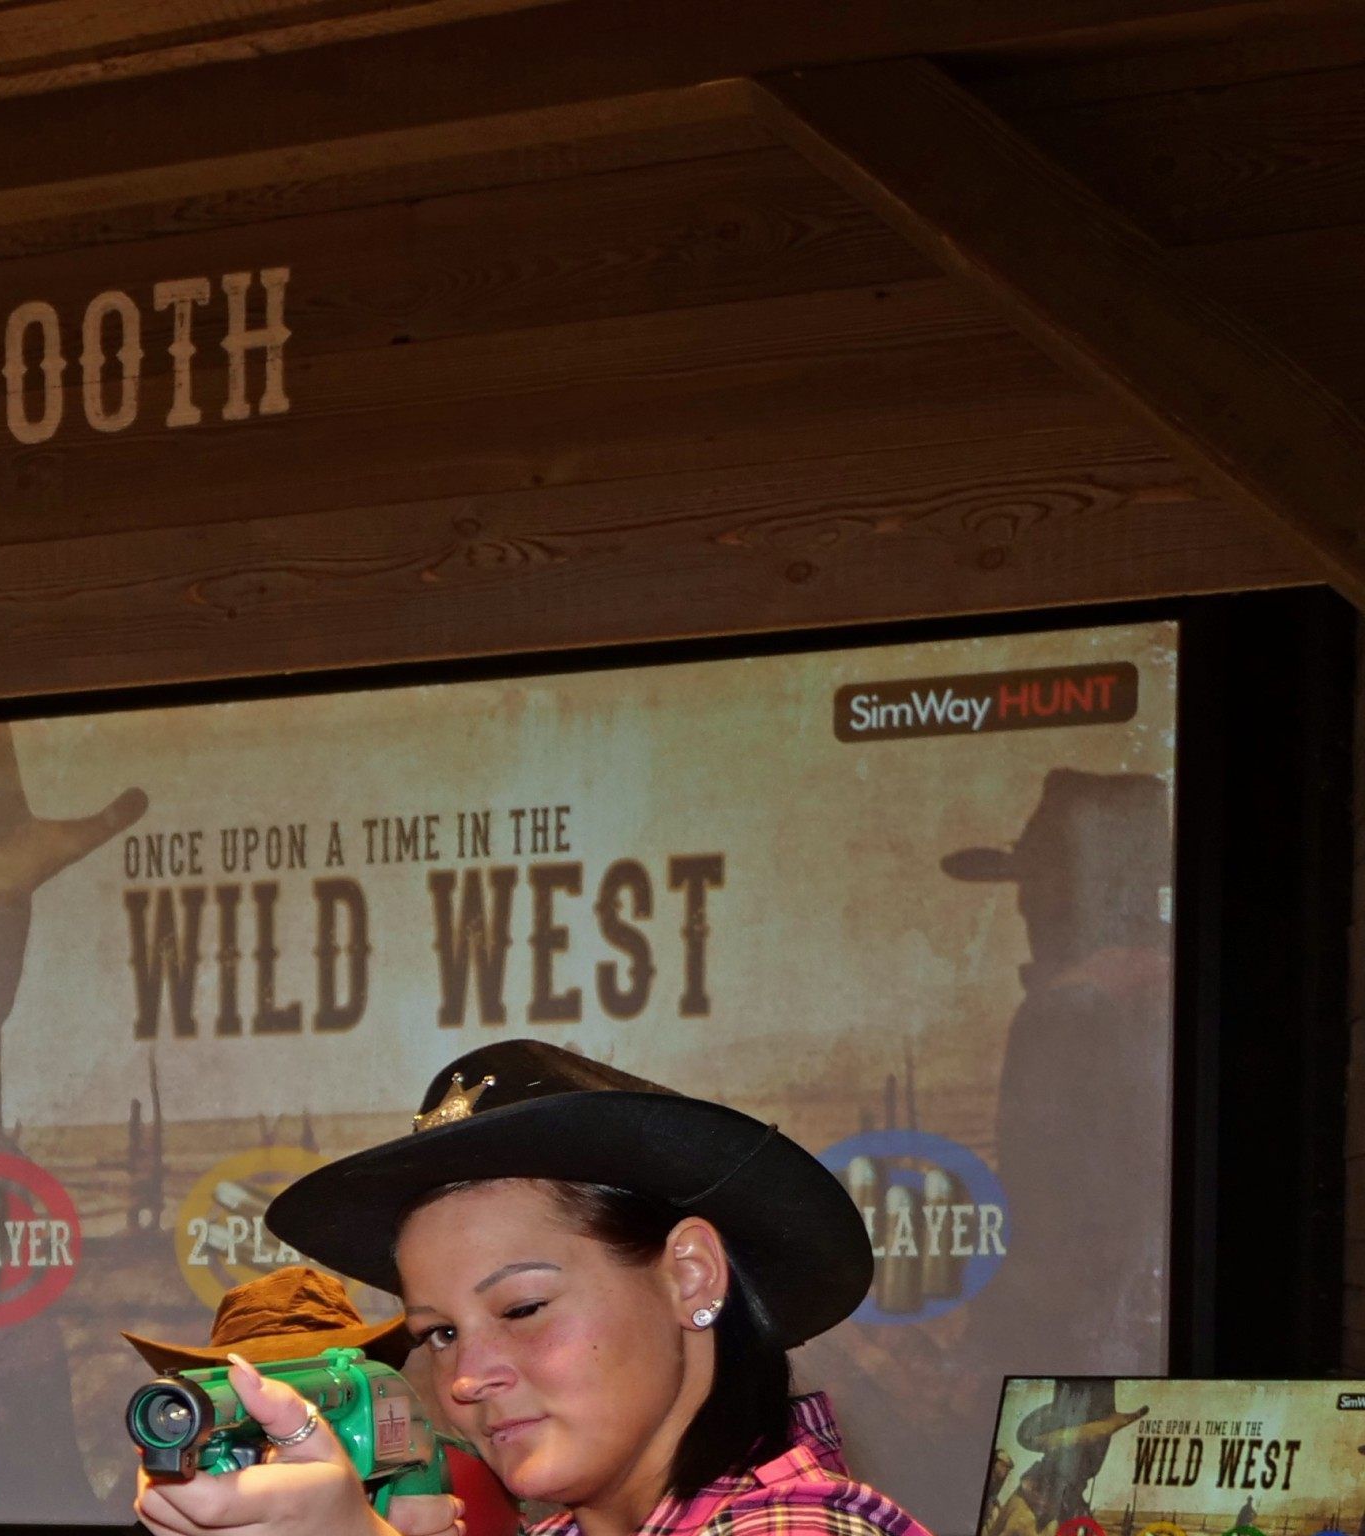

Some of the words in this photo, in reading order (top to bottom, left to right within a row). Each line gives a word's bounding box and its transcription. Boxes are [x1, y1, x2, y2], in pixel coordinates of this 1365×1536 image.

[850, 688, 991, 732] SimWay
[999, 675, 1118, 720] HUNT
[124, 830, 203, 879] ONCE
[220, 823, 307, 873] UPON
[325, 820, 344, 867] A
[362, 814, 440, 864] TIME
[457, 811, 491, 858] IN
[510, 806, 571, 853] THE
[123, 876, 371, 1040] WILD
[428, 853, 725, 1028] WEST
[187, 1217, 209, 1266] 2
[862, 1203, 1008, 1257] LAYER
[1138, 1420, 1161, 1435] ONCE
[1166, 1420, 1191, 1435] UPON
[1194, 1421, 1201, 1435] A
[1205, 1421, 1227, 1435] TIME
[1230, 1421, 1240, 1436] IN
[1245, 1421, 1264, 1436] THE
[1133, 1436, 1204, 1486] WILD
[1216, 1438, 1301, 1490] WEST
